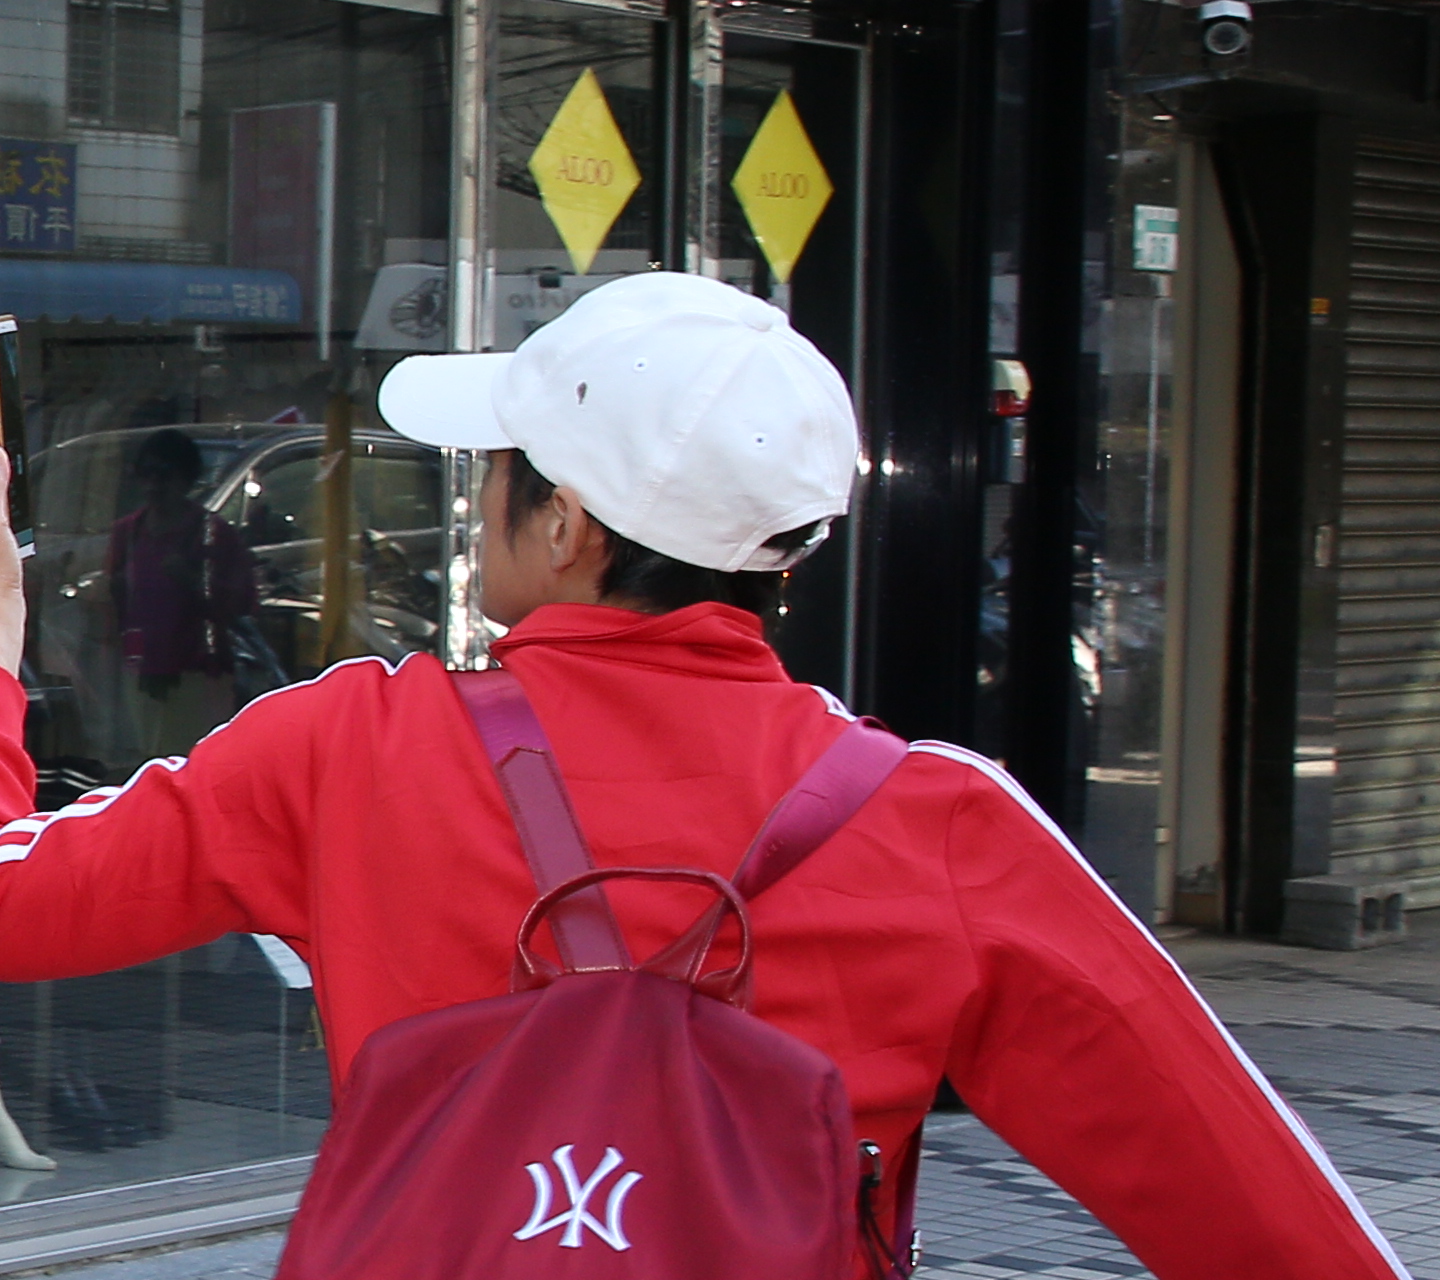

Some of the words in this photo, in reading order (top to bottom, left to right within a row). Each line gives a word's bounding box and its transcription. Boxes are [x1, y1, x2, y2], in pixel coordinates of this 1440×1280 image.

[556, 155, 615, 187] ALOO
[756, 172, 809, 199] ALOO
[512, 1143, 644, 1252] NY
